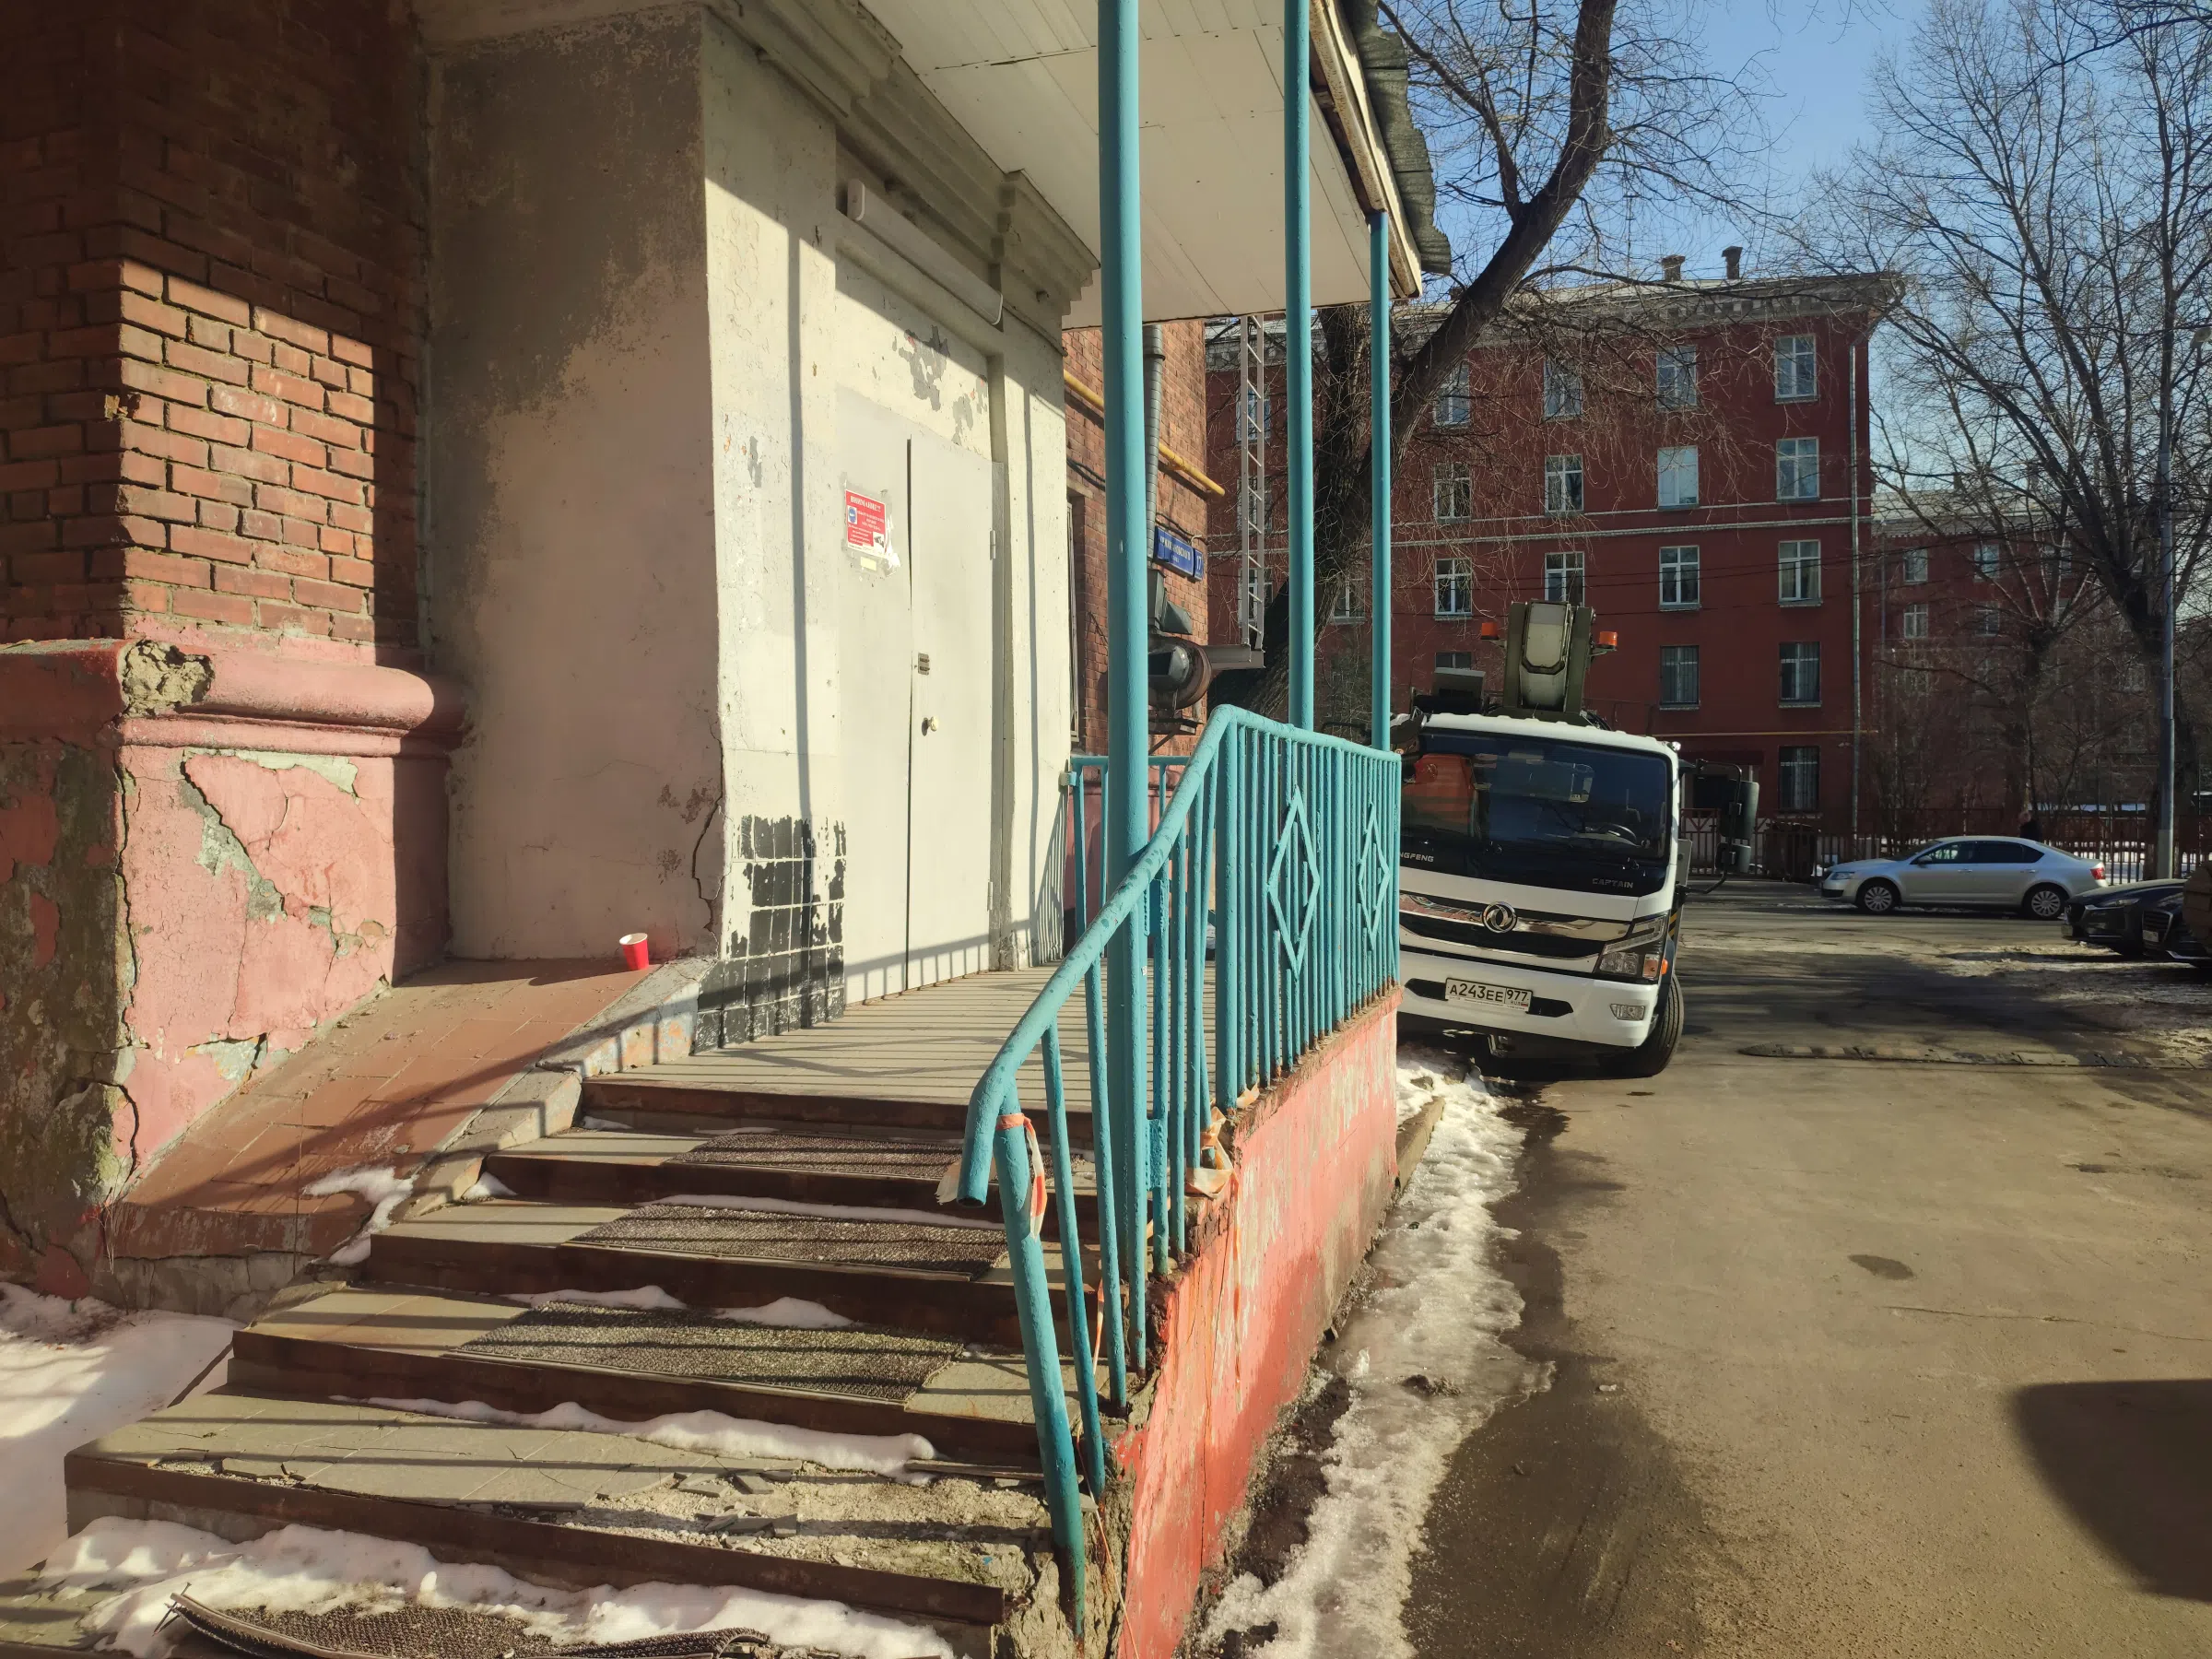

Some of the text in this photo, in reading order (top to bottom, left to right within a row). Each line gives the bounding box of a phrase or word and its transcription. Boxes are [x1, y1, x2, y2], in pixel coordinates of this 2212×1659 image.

[1196, 555, 1202, 571] 17
[1399, 852, 1434, 863] NGFENG
[1592, 877, 1634, 888] CAPTAIN
[1506, 989, 1528, 1002] 977
